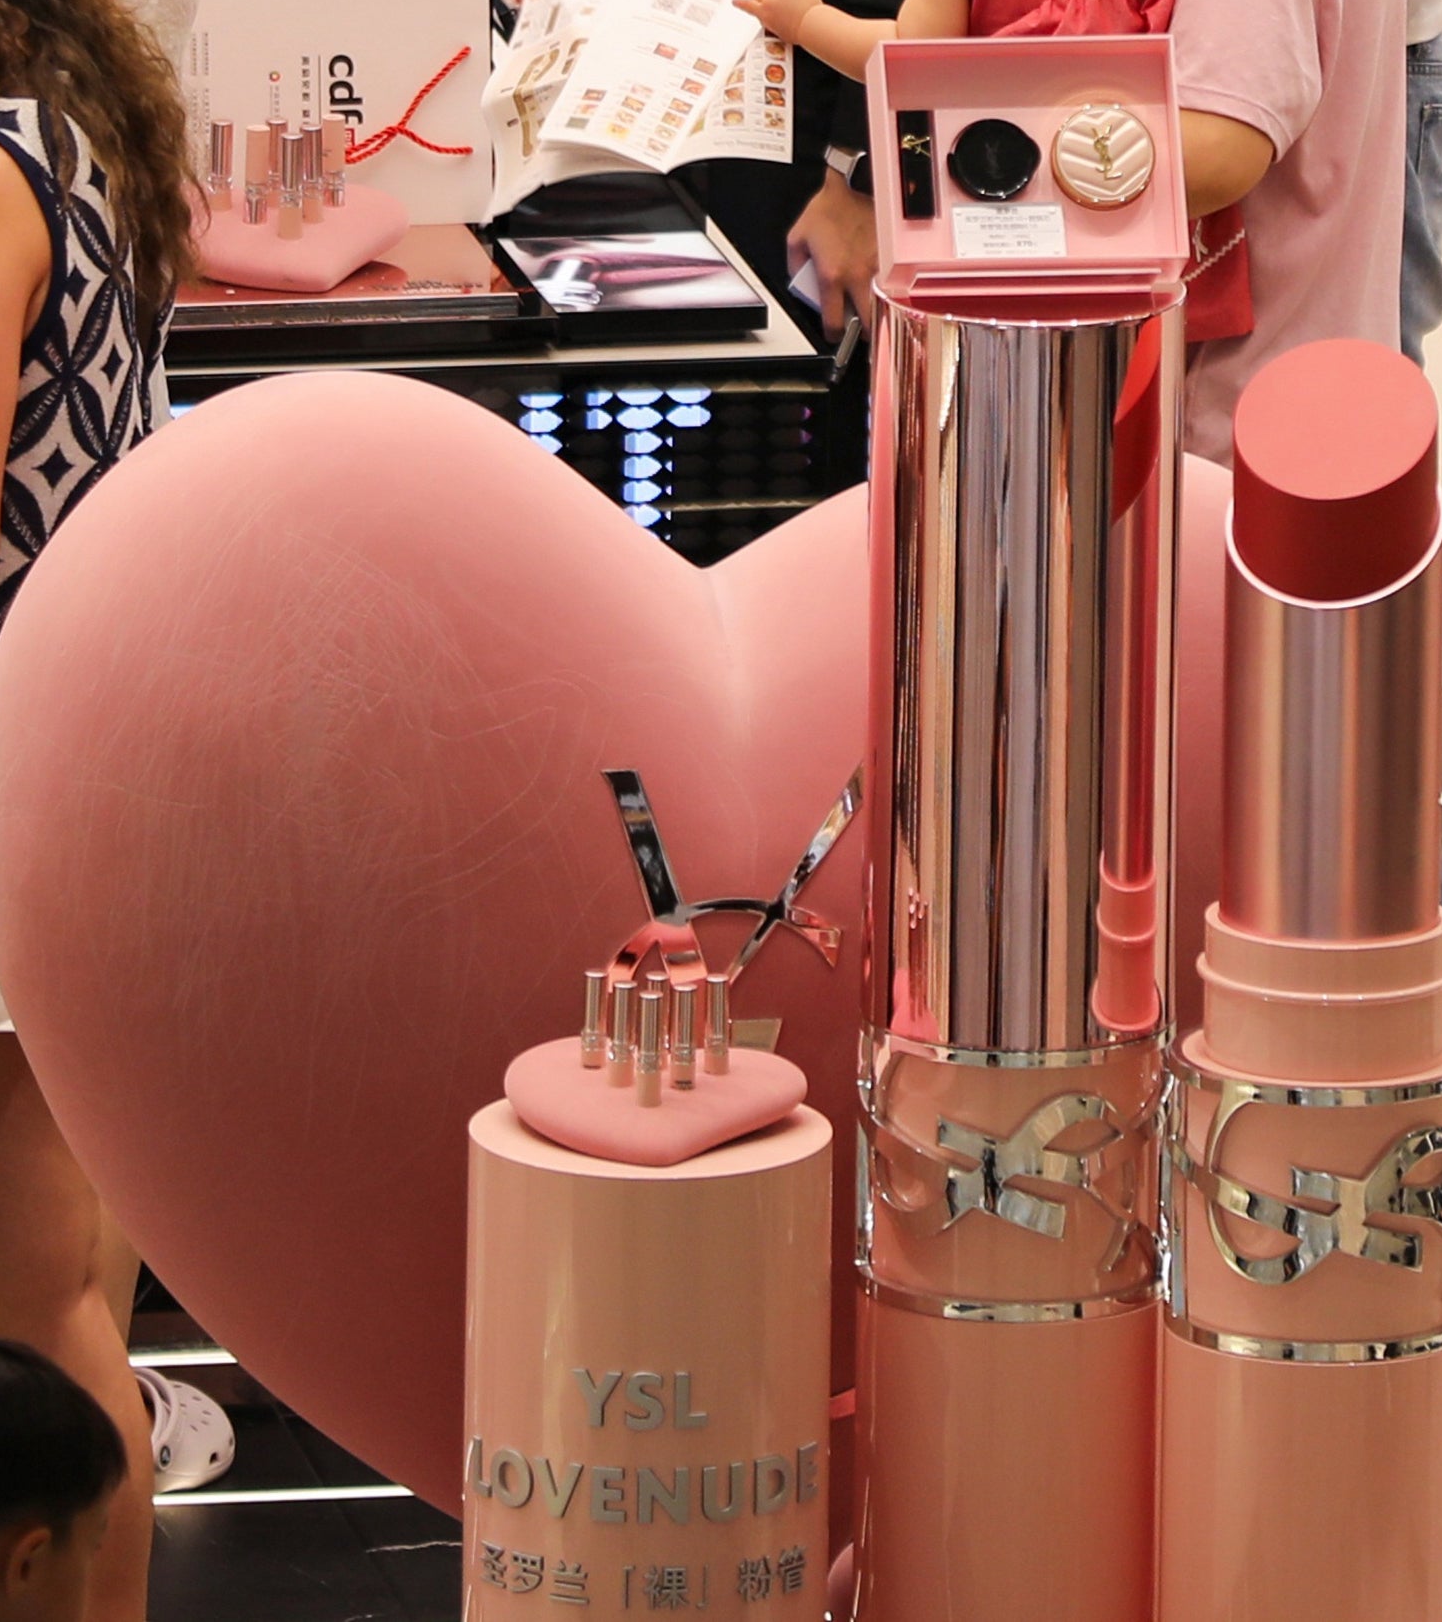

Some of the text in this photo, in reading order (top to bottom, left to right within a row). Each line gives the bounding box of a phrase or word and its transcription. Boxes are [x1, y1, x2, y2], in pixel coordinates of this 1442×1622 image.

[328, 54, 363, 124] cdf
[572, 1368, 707, 1430] YSL
[469, 1434, 819, 1525] LOVENUDE
